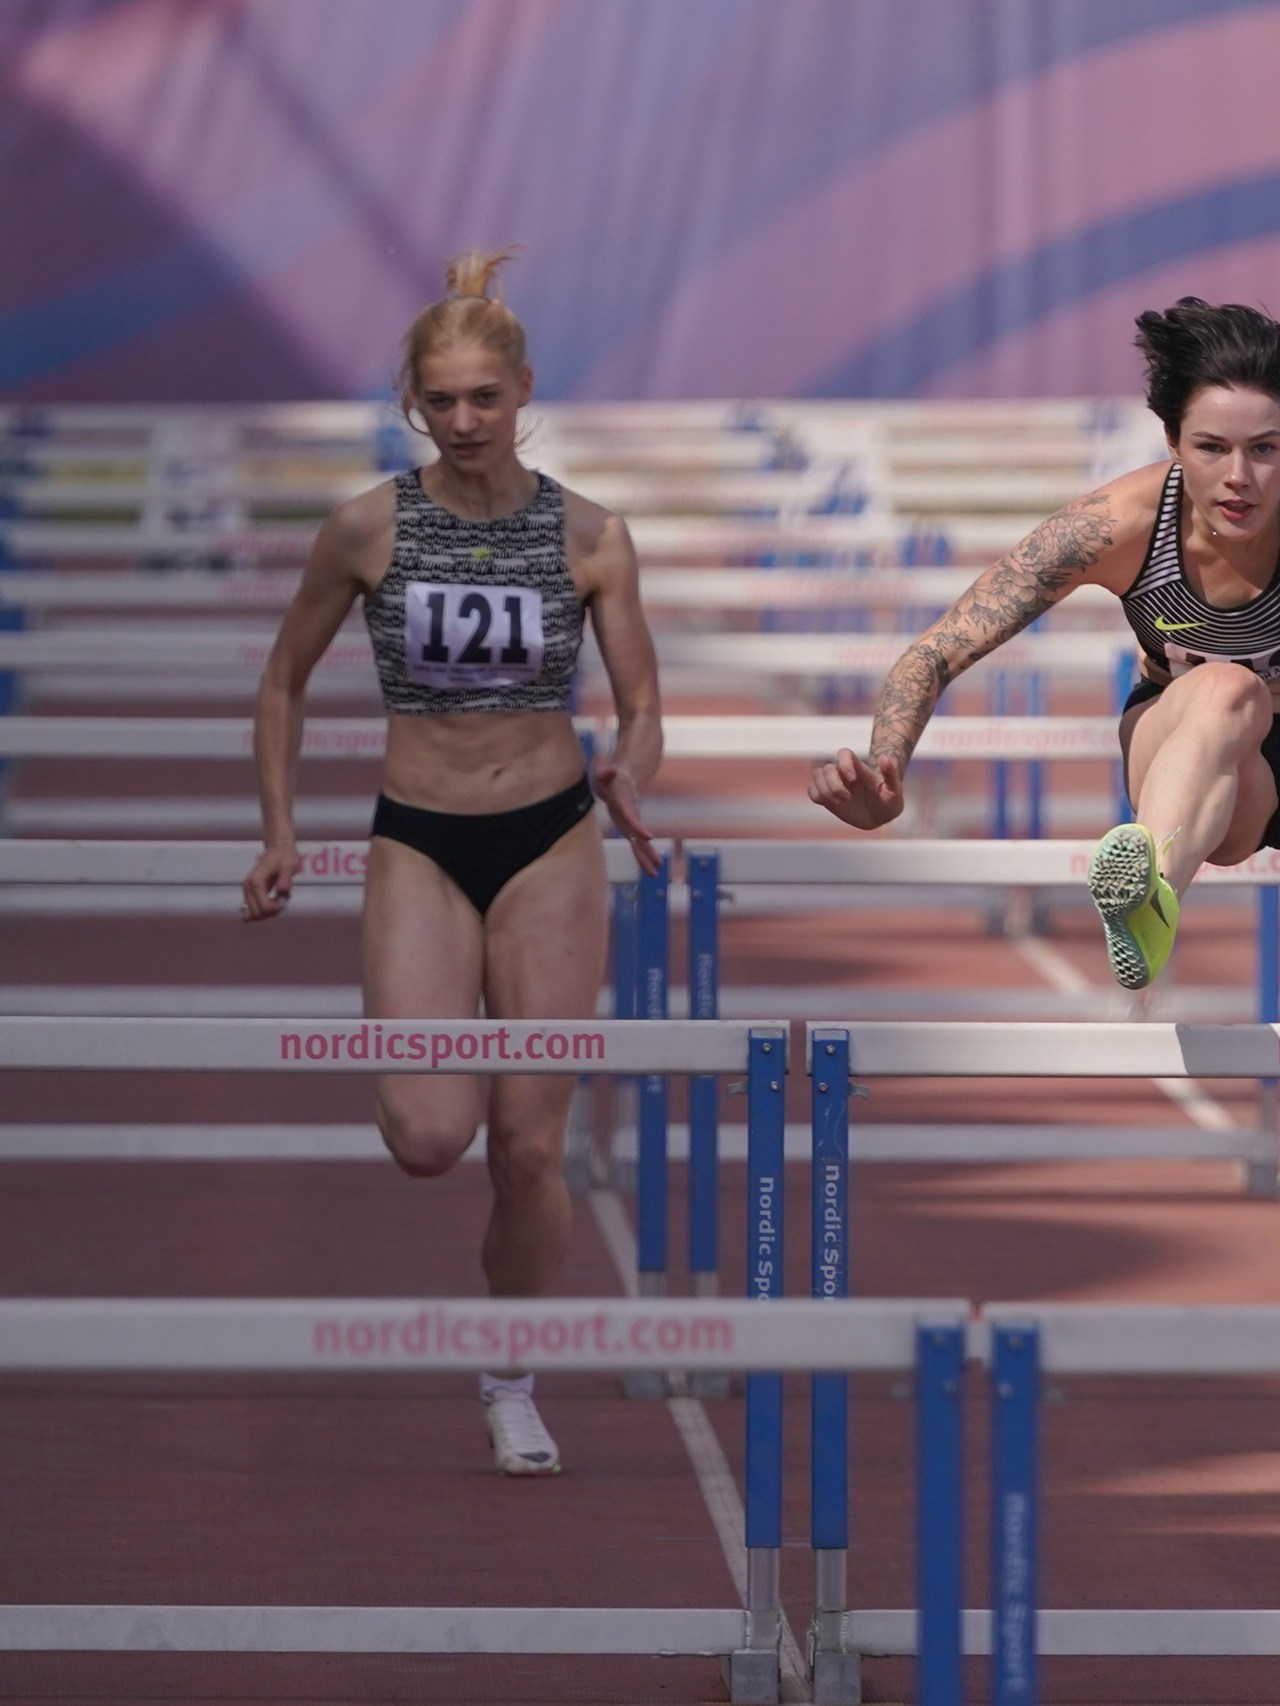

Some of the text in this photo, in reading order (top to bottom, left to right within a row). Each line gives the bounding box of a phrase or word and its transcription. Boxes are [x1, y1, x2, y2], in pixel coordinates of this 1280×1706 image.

[422, 591, 528, 664] 121
[280, 1024, 605, 1067] nordicsport.com
[753, 1176, 775, 1304] nordic Spo
[820, 1164, 842, 1302] nordic Spo
[313, 1309, 732, 1364] nordicsport.com
